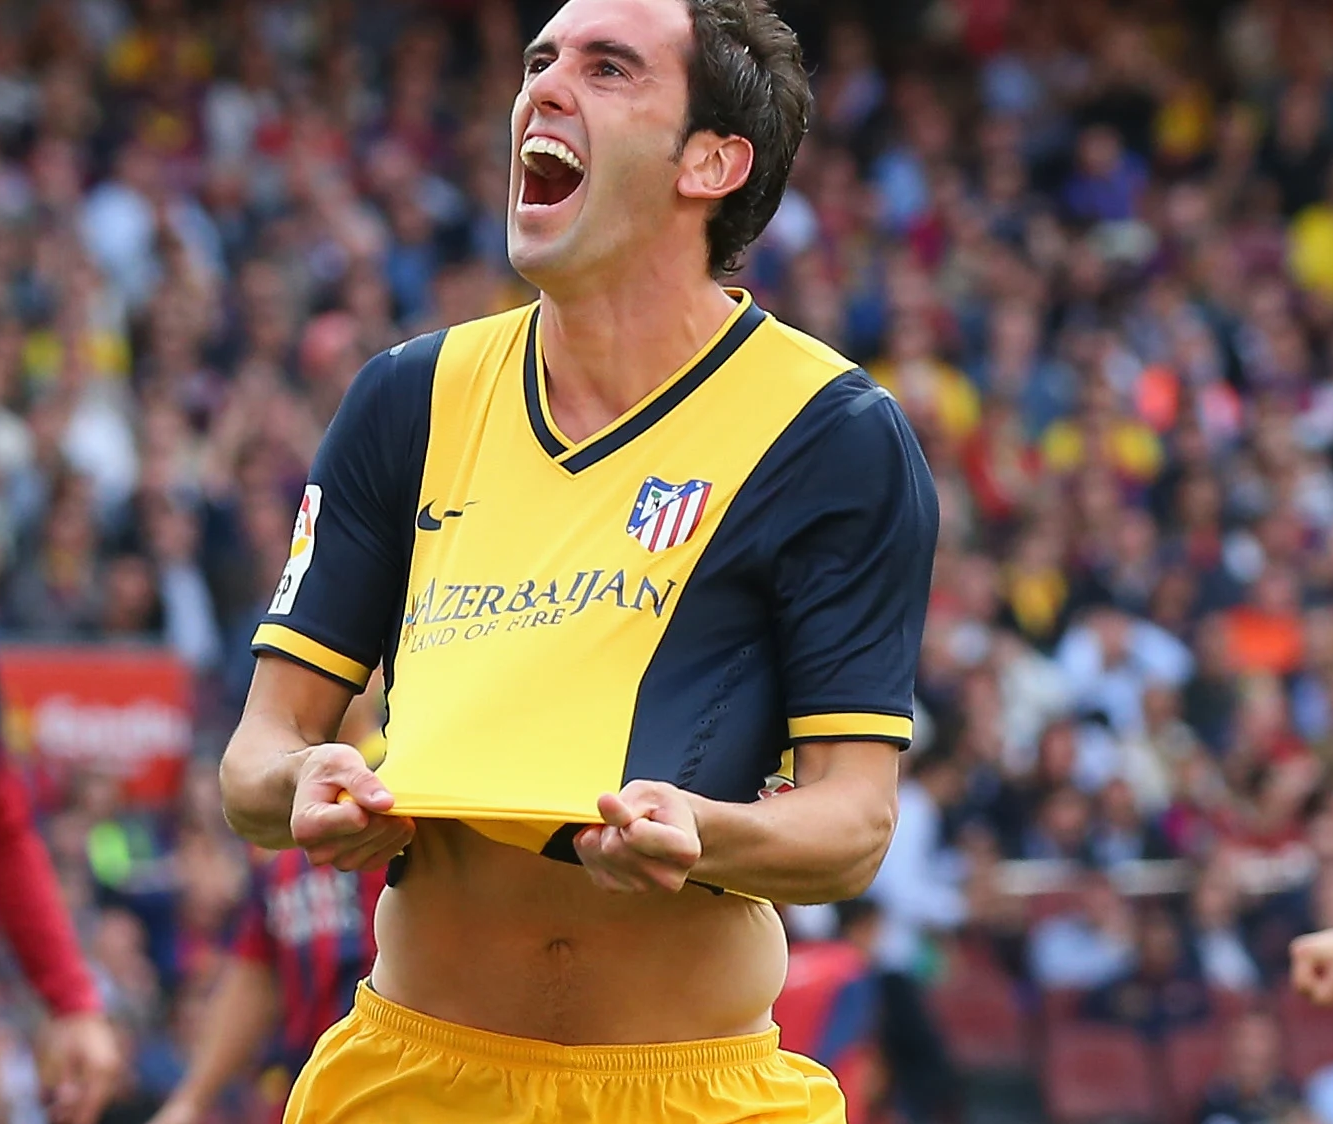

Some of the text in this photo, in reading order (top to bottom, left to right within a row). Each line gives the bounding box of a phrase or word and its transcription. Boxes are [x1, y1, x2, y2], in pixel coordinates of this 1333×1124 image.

[413, 568, 677, 626] AZERBAIJAN
[410, 607, 567, 654] LAND OF FIRE
